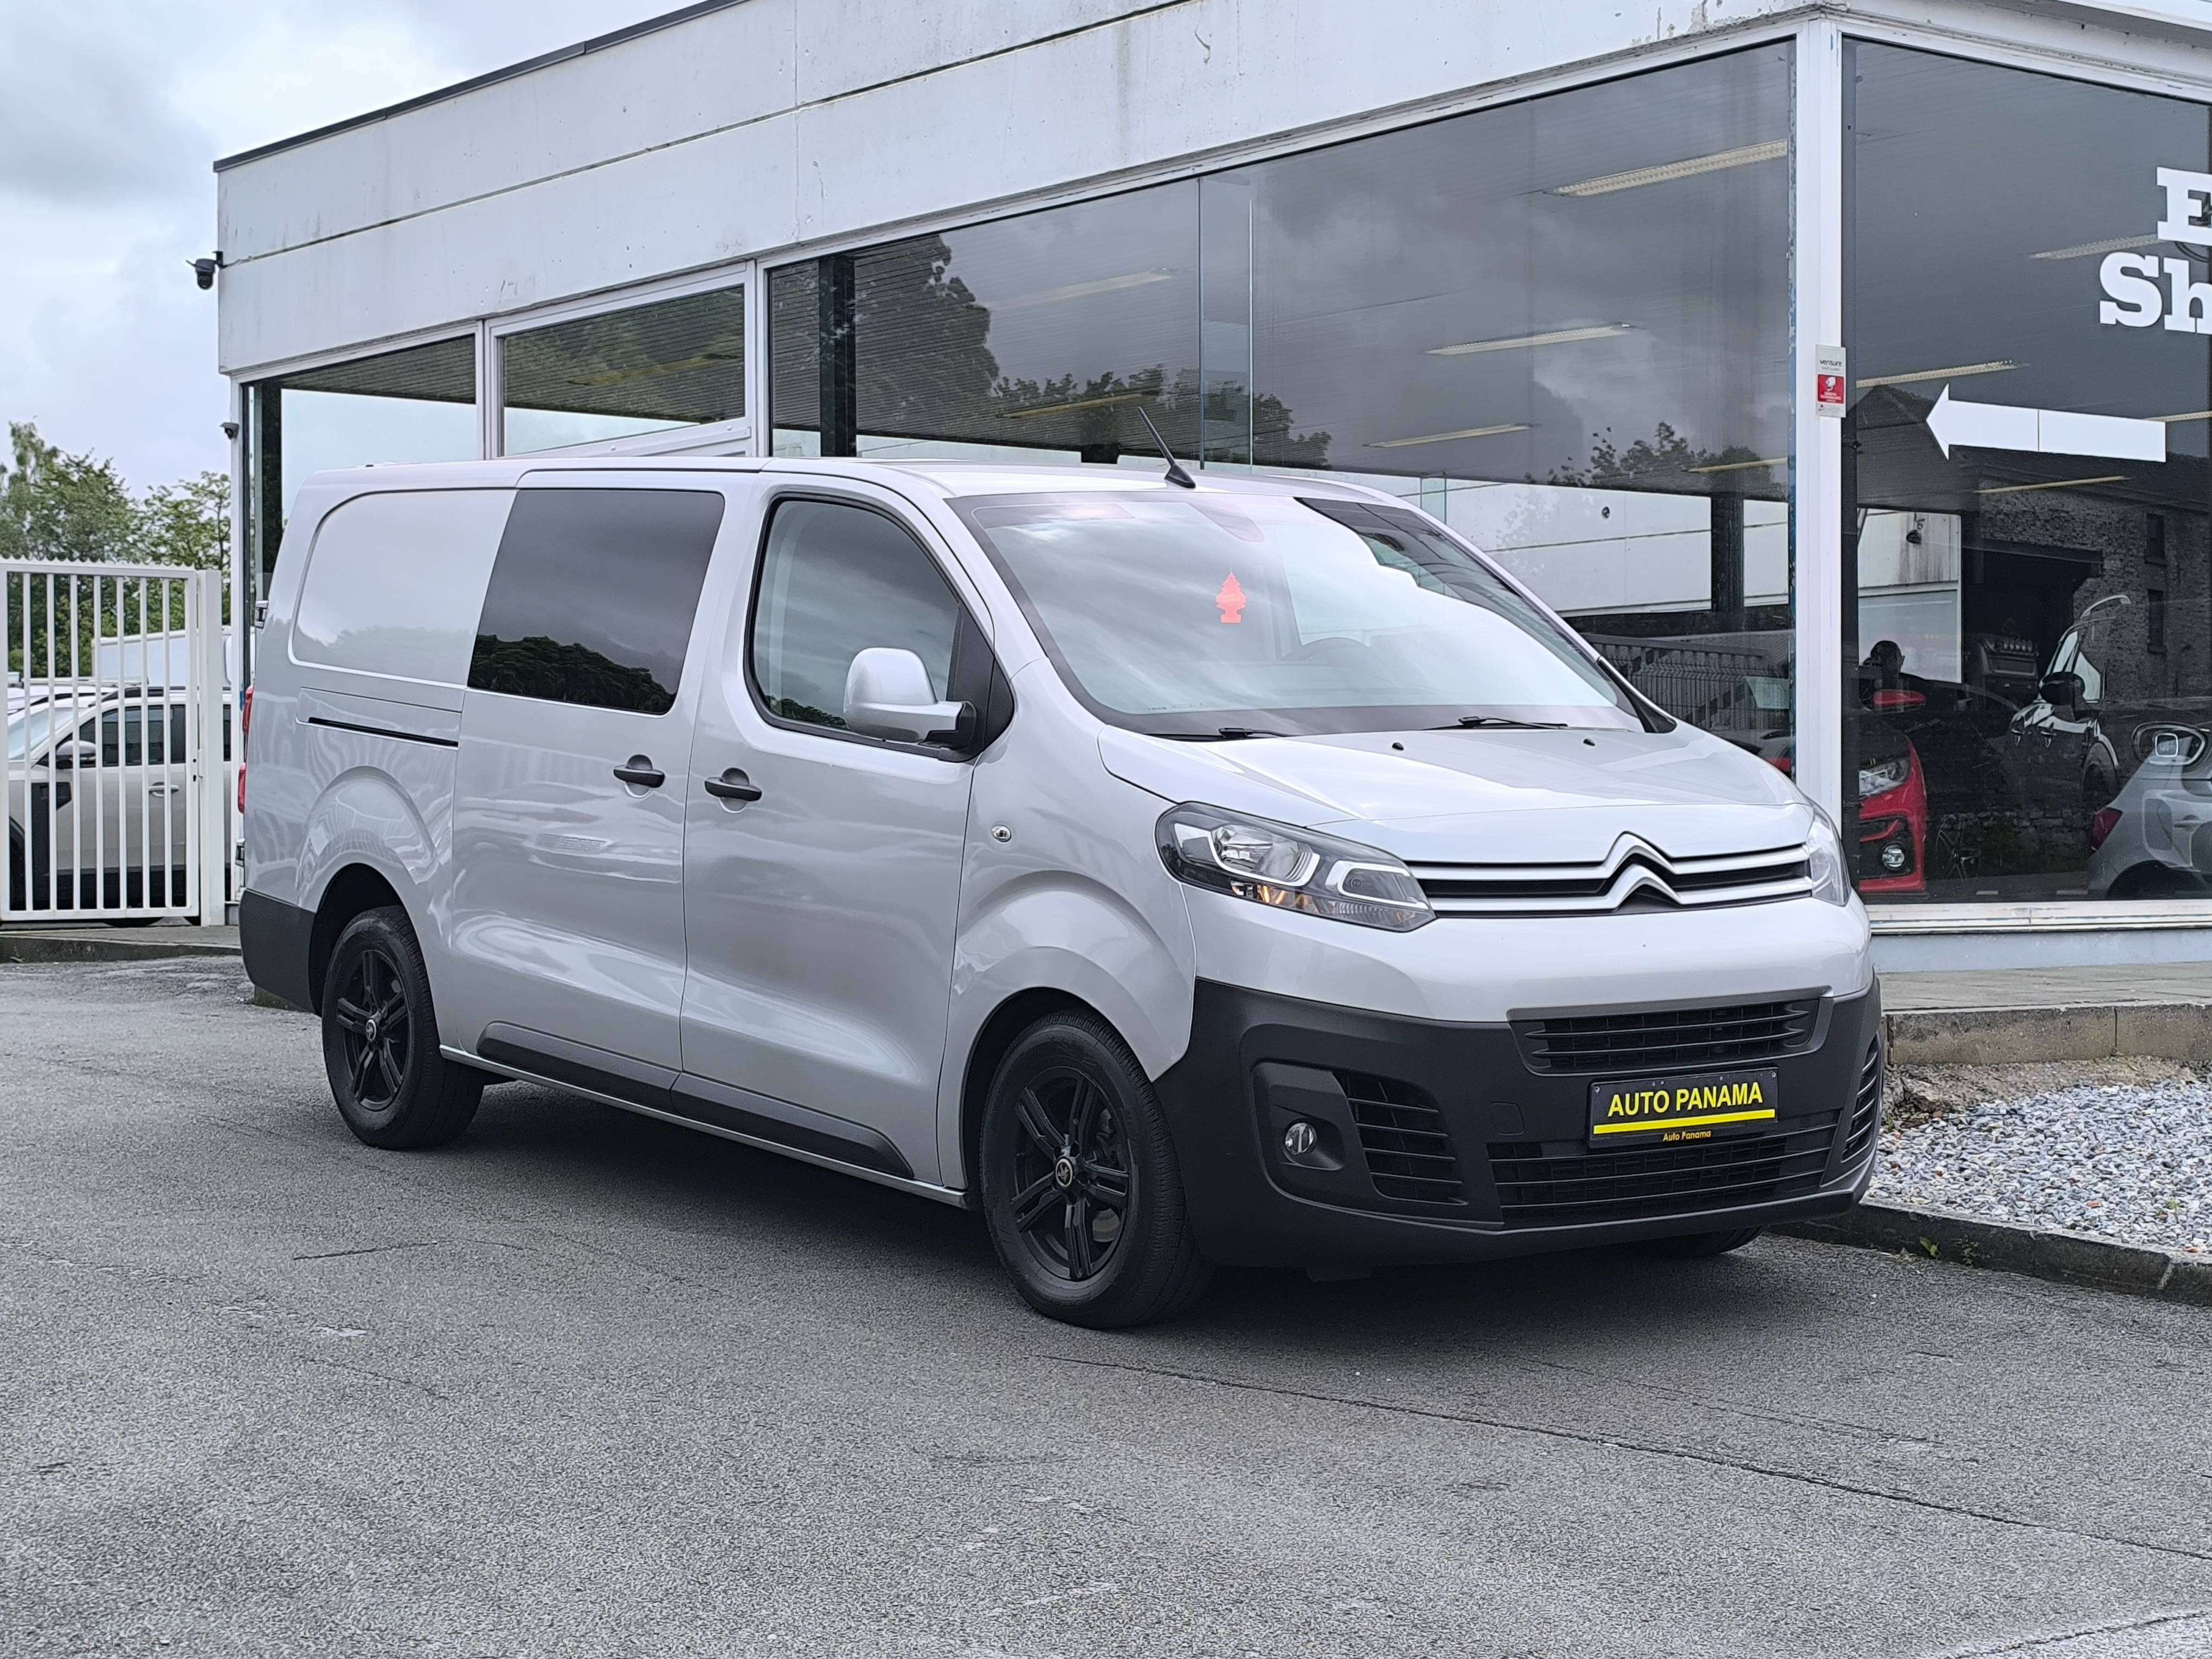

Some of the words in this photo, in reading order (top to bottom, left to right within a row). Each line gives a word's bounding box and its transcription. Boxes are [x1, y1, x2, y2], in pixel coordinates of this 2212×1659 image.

[1607, 1090, 1670, 1117] AUTO
[1676, 1082, 1763, 1111] PANAMA
[1662, 1133, 1680, 1142] Auto
[1681, 1131, 1711, 1141] Panama
